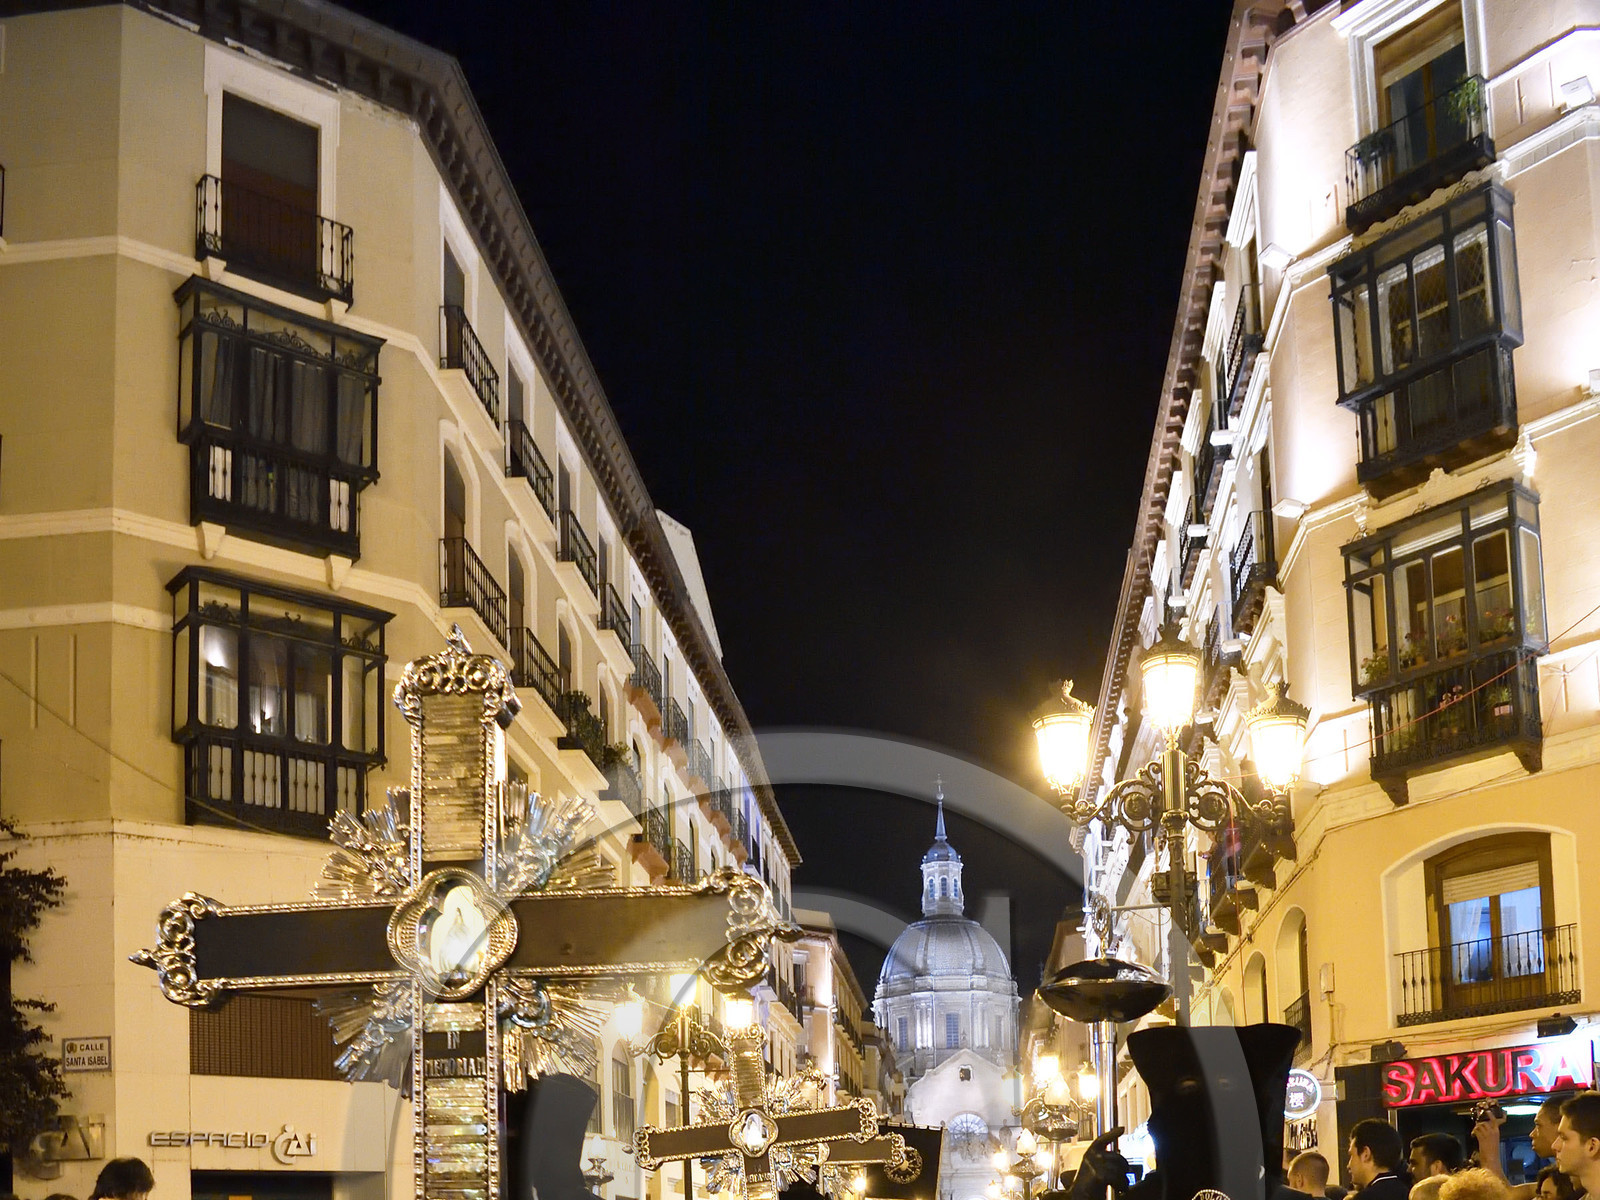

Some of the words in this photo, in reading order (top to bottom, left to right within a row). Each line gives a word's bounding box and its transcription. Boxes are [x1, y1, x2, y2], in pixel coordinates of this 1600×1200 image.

[79, 1042, 105, 1052] CALLE
[447, 1031, 460, 1050] IN
[65, 1056, 87, 1067] SANTA
[87, 1055, 108, 1067] ISABEL
[1383, 1047, 1588, 1106] SAKURA
[149, 1131, 270, 1148] ESPACIO
